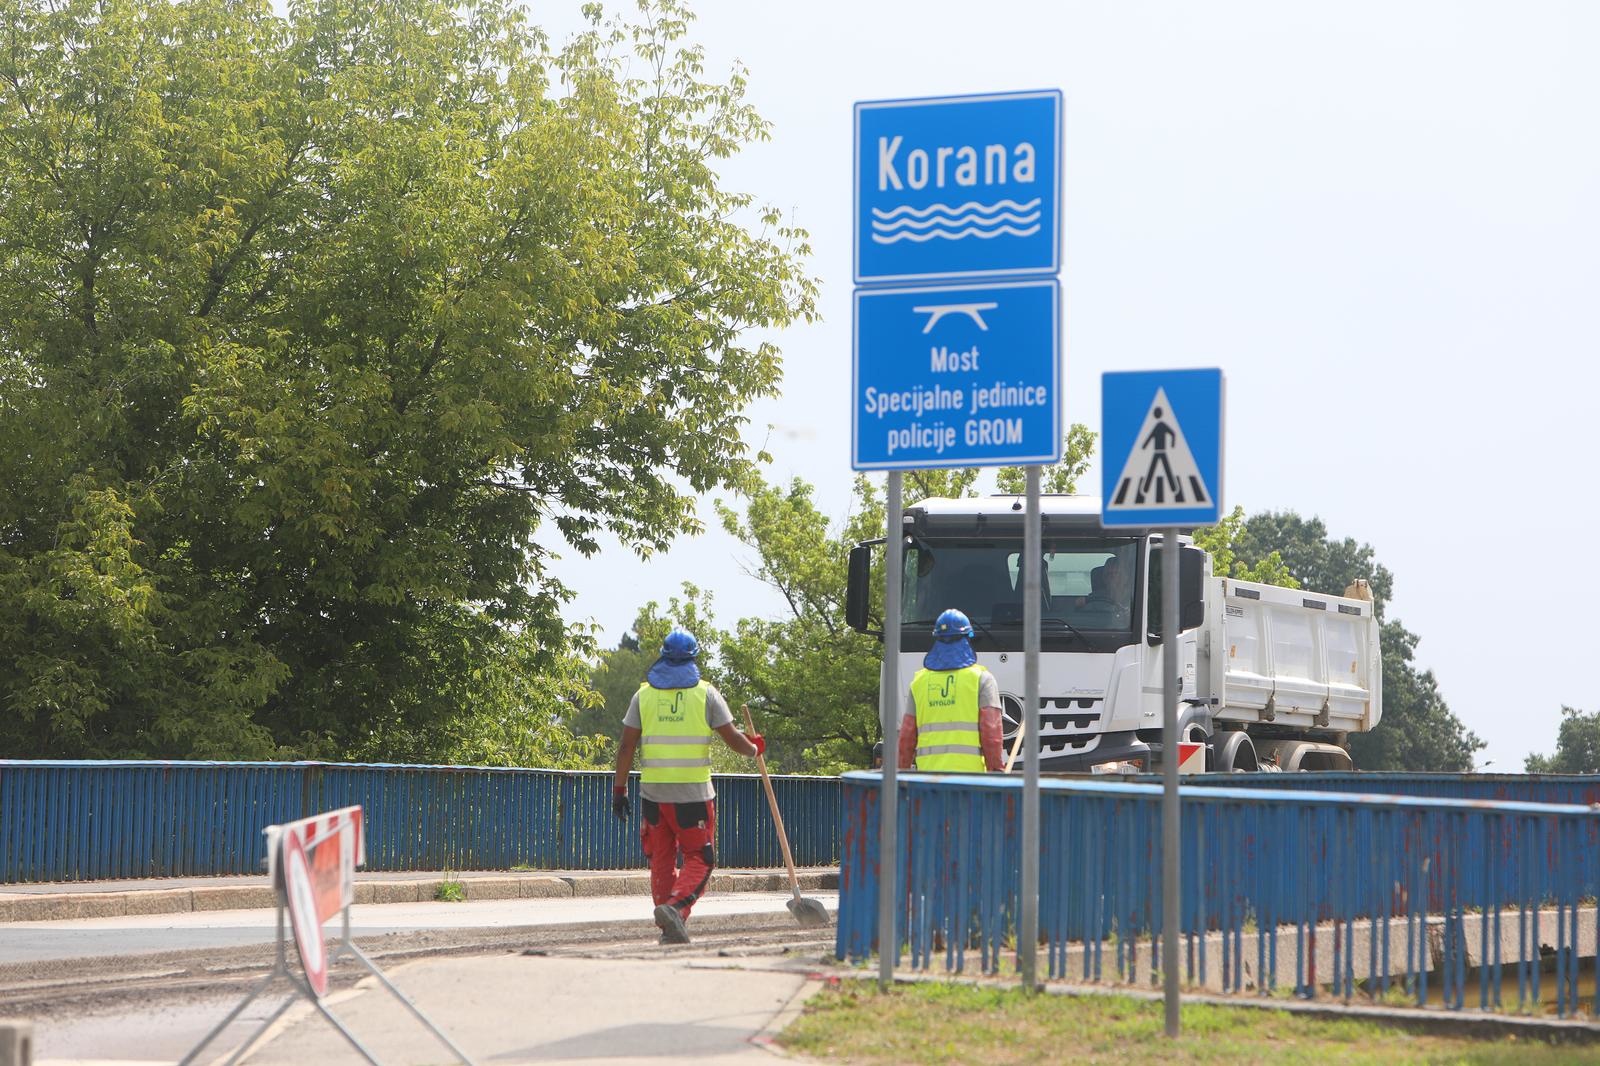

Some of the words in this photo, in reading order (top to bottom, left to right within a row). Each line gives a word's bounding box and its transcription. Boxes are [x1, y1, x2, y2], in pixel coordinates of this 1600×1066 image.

[878, 135, 1036, 191] Korana
[930, 346, 980, 373] Most
[865, 384, 964, 419] Specijalne
[970, 381, 1047, 415] jedinice
[888, 422, 956, 456] policije
[964, 418, 1023, 446] GROM
